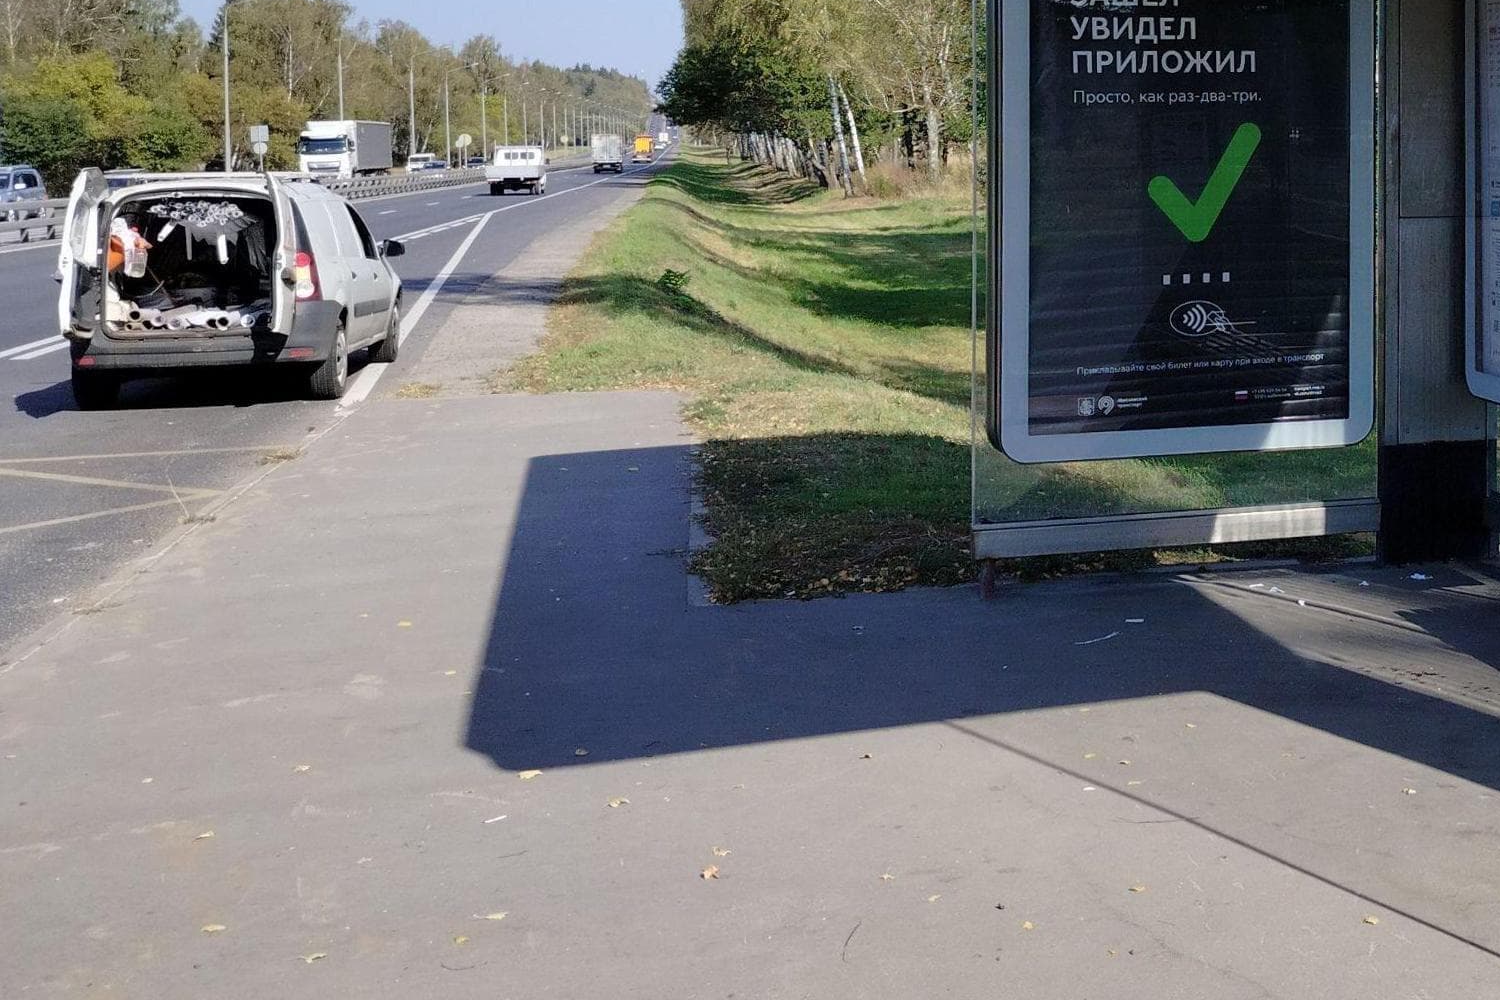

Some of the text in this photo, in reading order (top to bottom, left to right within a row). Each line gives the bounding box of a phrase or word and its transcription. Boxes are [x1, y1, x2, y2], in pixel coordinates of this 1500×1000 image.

[1070, 16, 1196, 44] УВИДЕЛ
[1071, 50, 1256, 74] ПРИЛОЖИЛ
[1073, 90, 1262, 106] Просто, как раз-два-три.
[1168, 360, 1192, 370] билет
[1194, 359, 1209, 368] или
[1211, 358, 1233, 369] карту
[1284, 352, 1325, 365] транспорт
